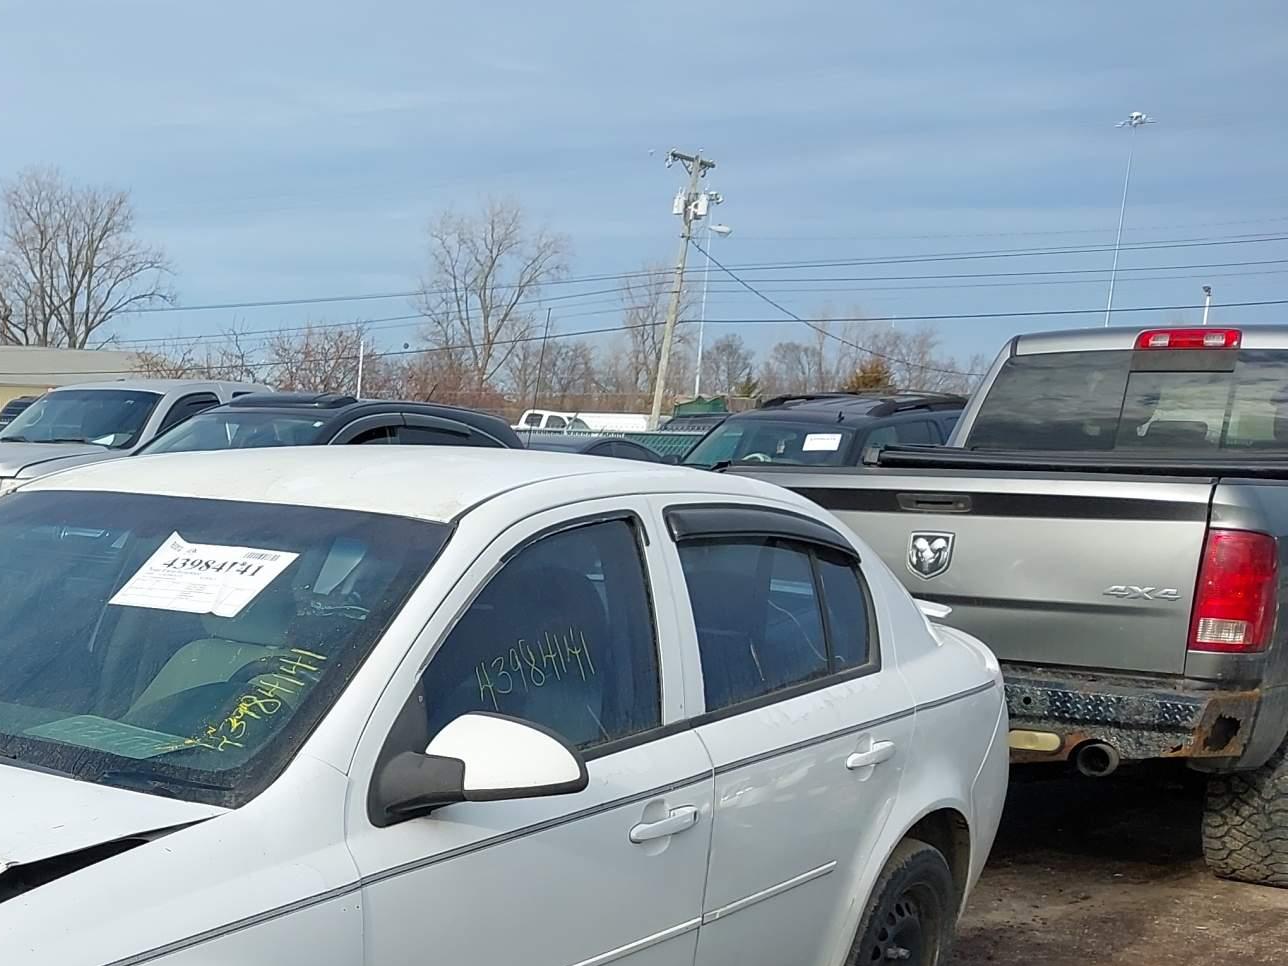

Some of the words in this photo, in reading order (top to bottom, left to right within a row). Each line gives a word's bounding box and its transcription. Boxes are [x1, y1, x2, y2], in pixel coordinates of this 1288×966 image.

[162, 557, 265, 577] 43984141
[1102, 585, 1183, 602] 4X4
[475, 625, 596, 712] 43984141
